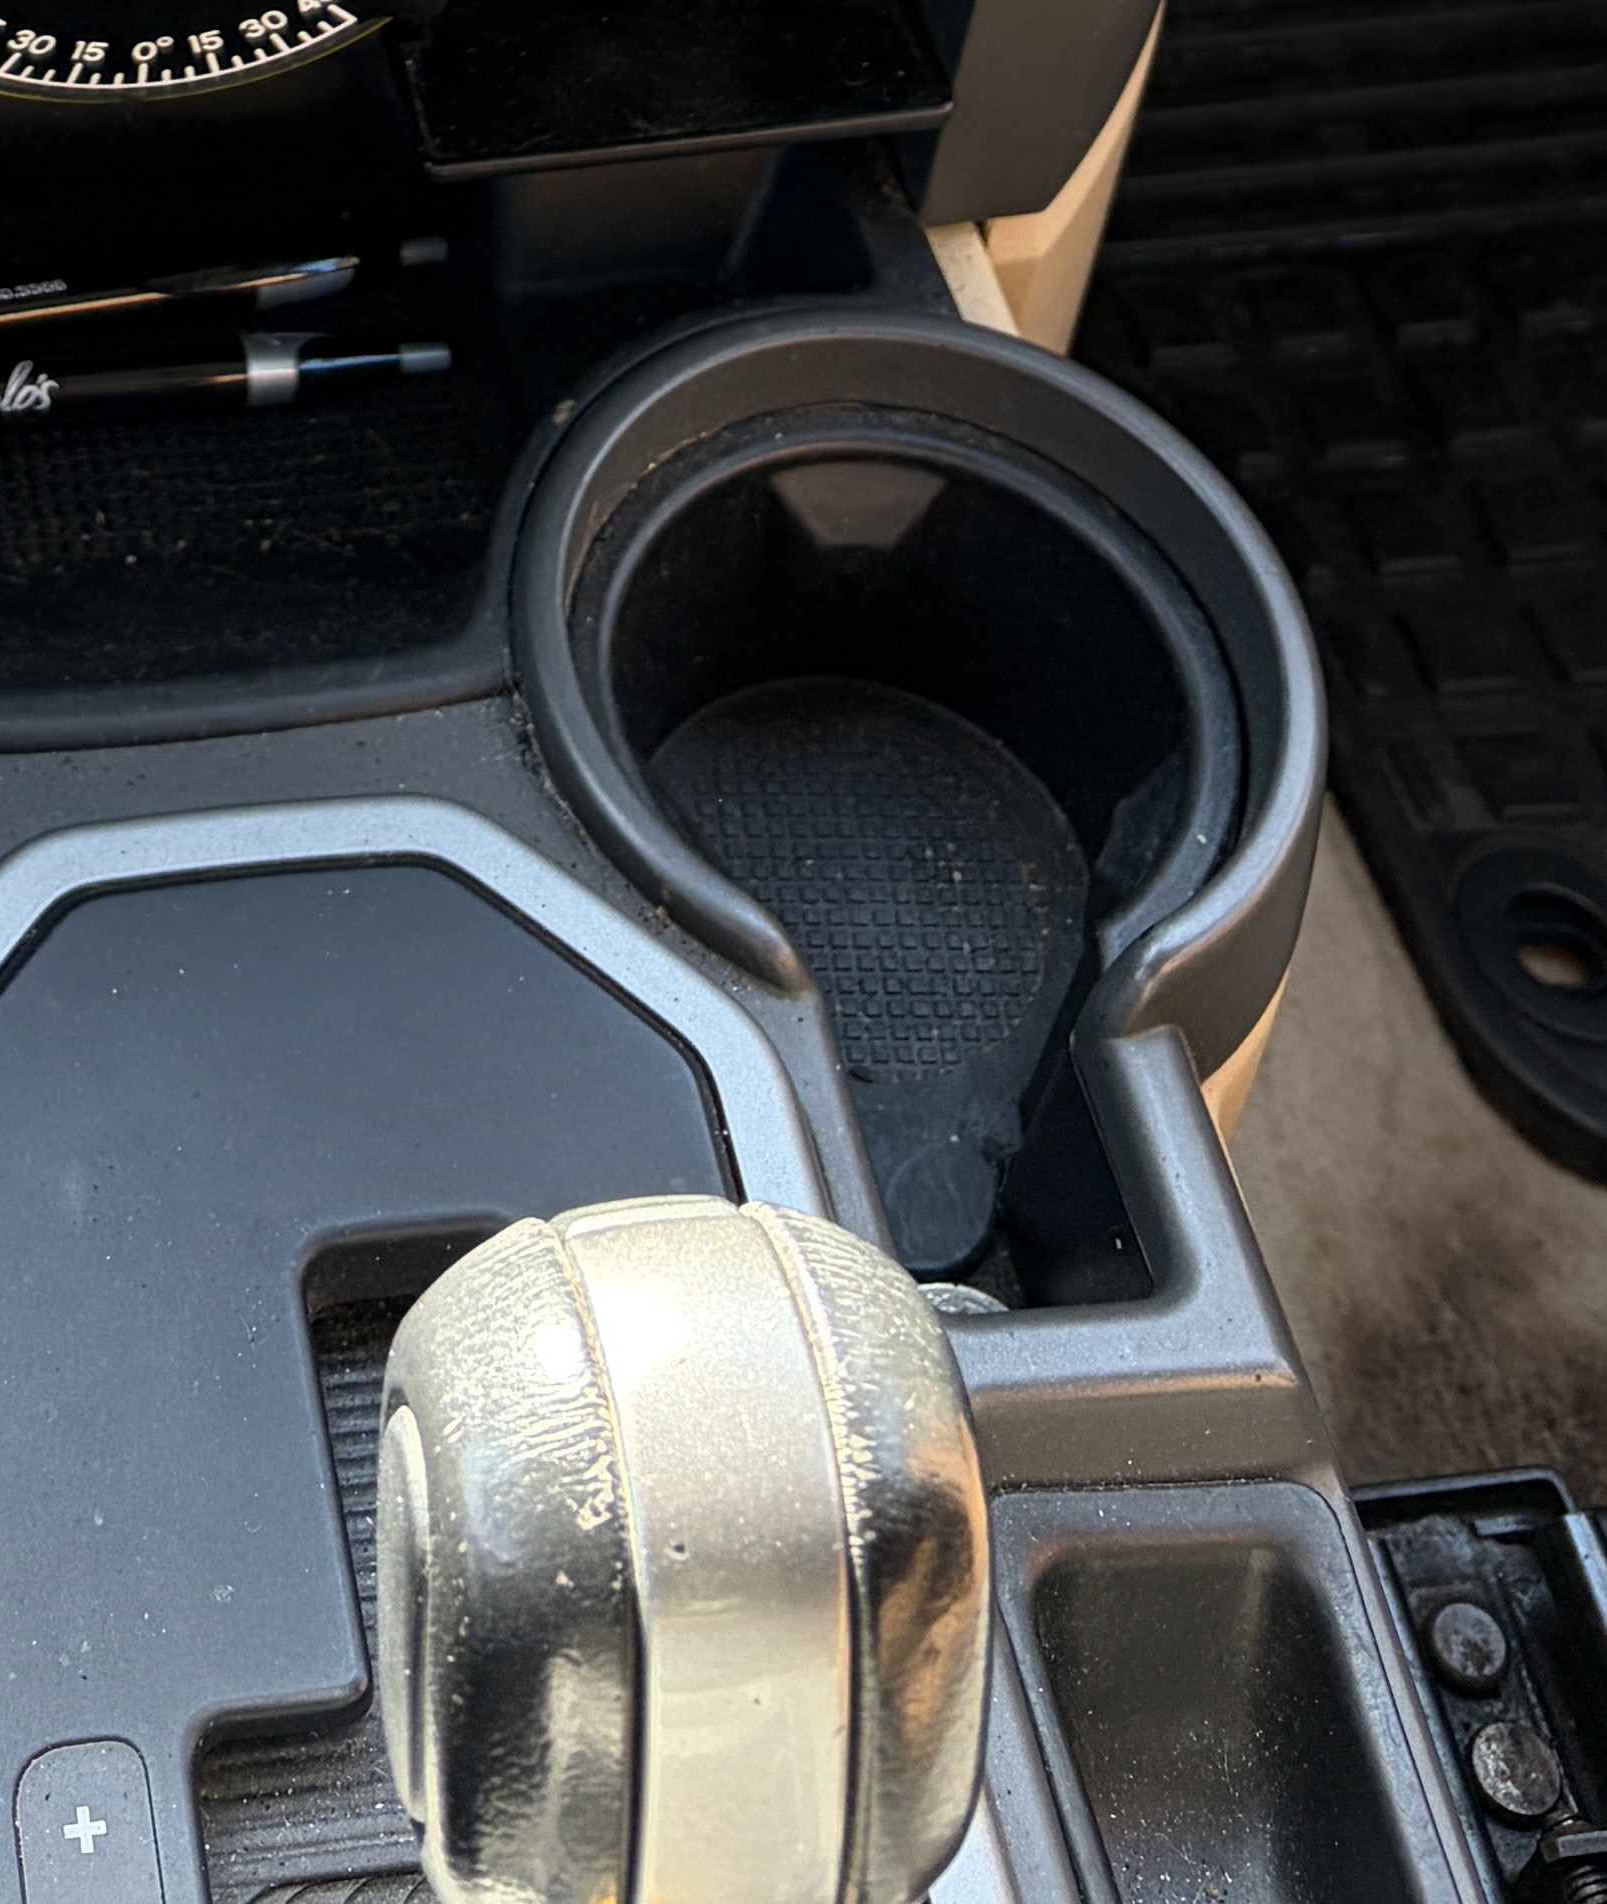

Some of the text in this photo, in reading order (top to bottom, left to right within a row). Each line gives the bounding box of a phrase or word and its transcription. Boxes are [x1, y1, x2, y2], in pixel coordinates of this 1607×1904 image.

[7, 29, 56, 56] 30
[71, 41, 109, 62] 15
[188, 30, 224, 53] 15
[239, 10, 288, 39] 30
